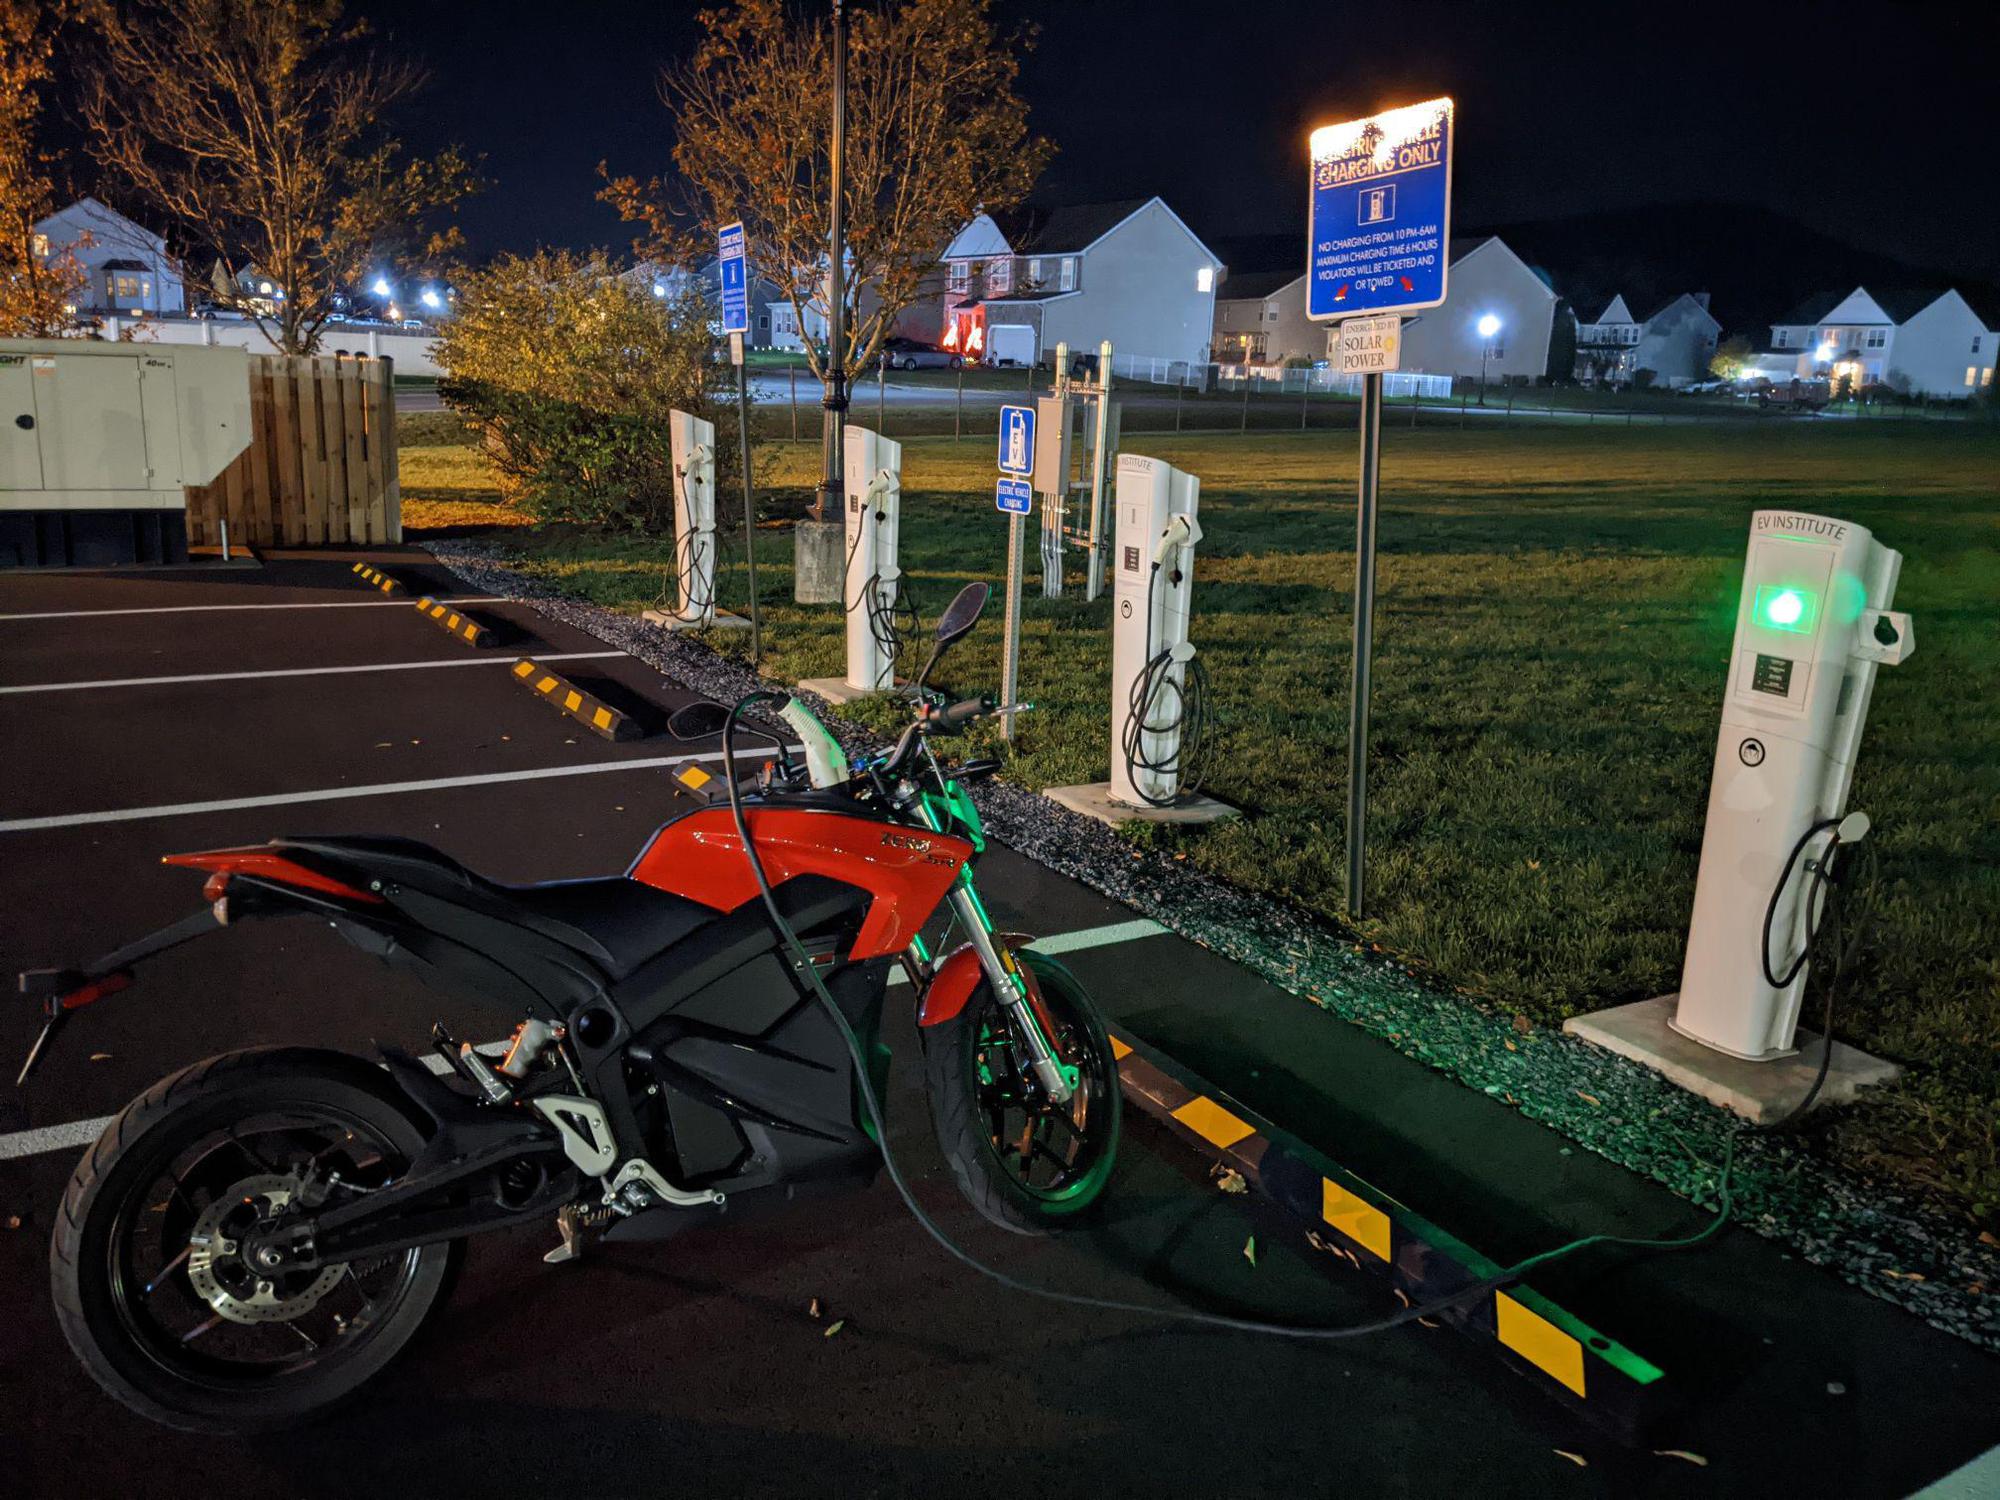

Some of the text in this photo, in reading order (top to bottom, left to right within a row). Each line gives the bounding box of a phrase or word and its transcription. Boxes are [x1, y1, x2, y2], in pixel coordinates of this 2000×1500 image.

[1319, 141, 1441, 185] CHARGING ONLY
[1318, 242, 1331, 253] NO
[1331, 235, 1372, 251] CHARGING
[1372, 232, 1394, 244] FROM
[1395, 229, 1405, 240] 10
[1316, 254, 1350, 268] MAXIMUM
[1350, 246, 1388, 262] CHARGING
[1389, 244, 1406, 256] TIME
[1411, 239, 1438, 252] HOURS
[1318, 254, 1435, 280] VIOLATORS WILL BE TICKETED AND
[1355, 276, 1394, 290] OR TOWED
[1344, 335, 1382, 352] SOLAR
[1344, 352, 1385, 369] POWER
[1757, 516, 1848, 541] EV INSTITUTE
